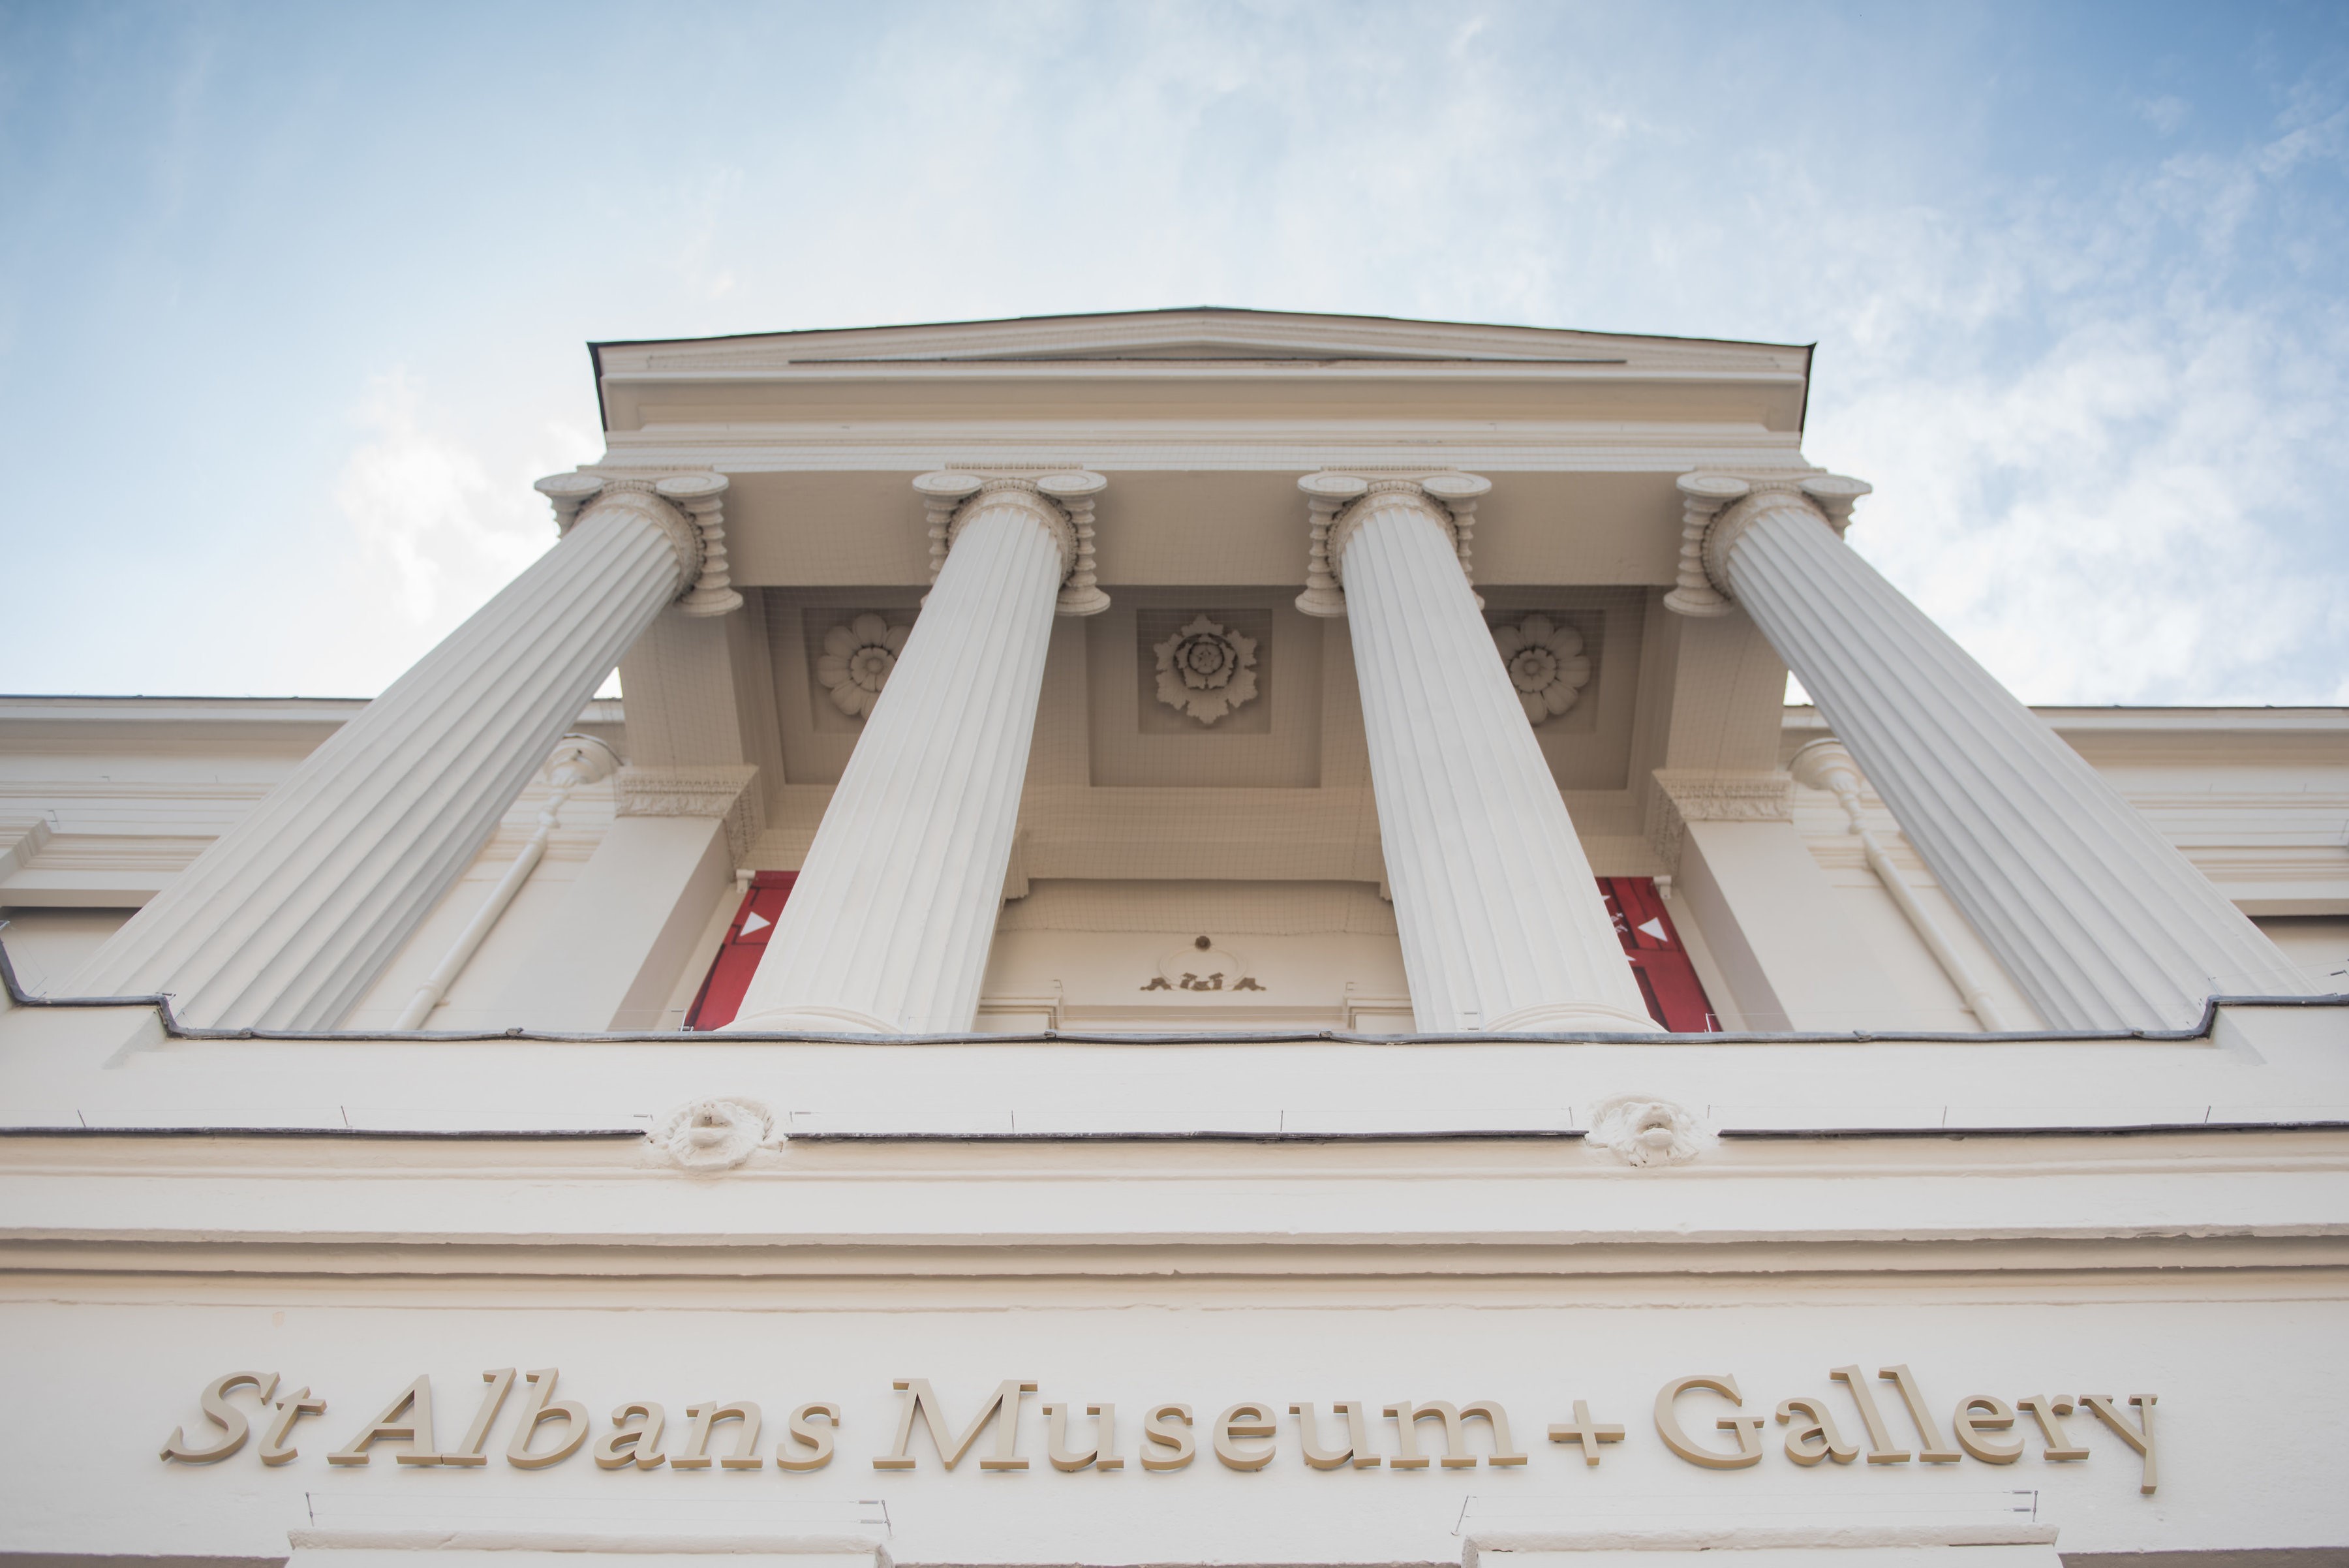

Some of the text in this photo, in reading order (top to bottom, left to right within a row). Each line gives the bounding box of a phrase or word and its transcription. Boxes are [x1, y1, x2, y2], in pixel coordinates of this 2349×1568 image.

[159, 1363, 2158, 1496] St Albans Museum + Gallery
